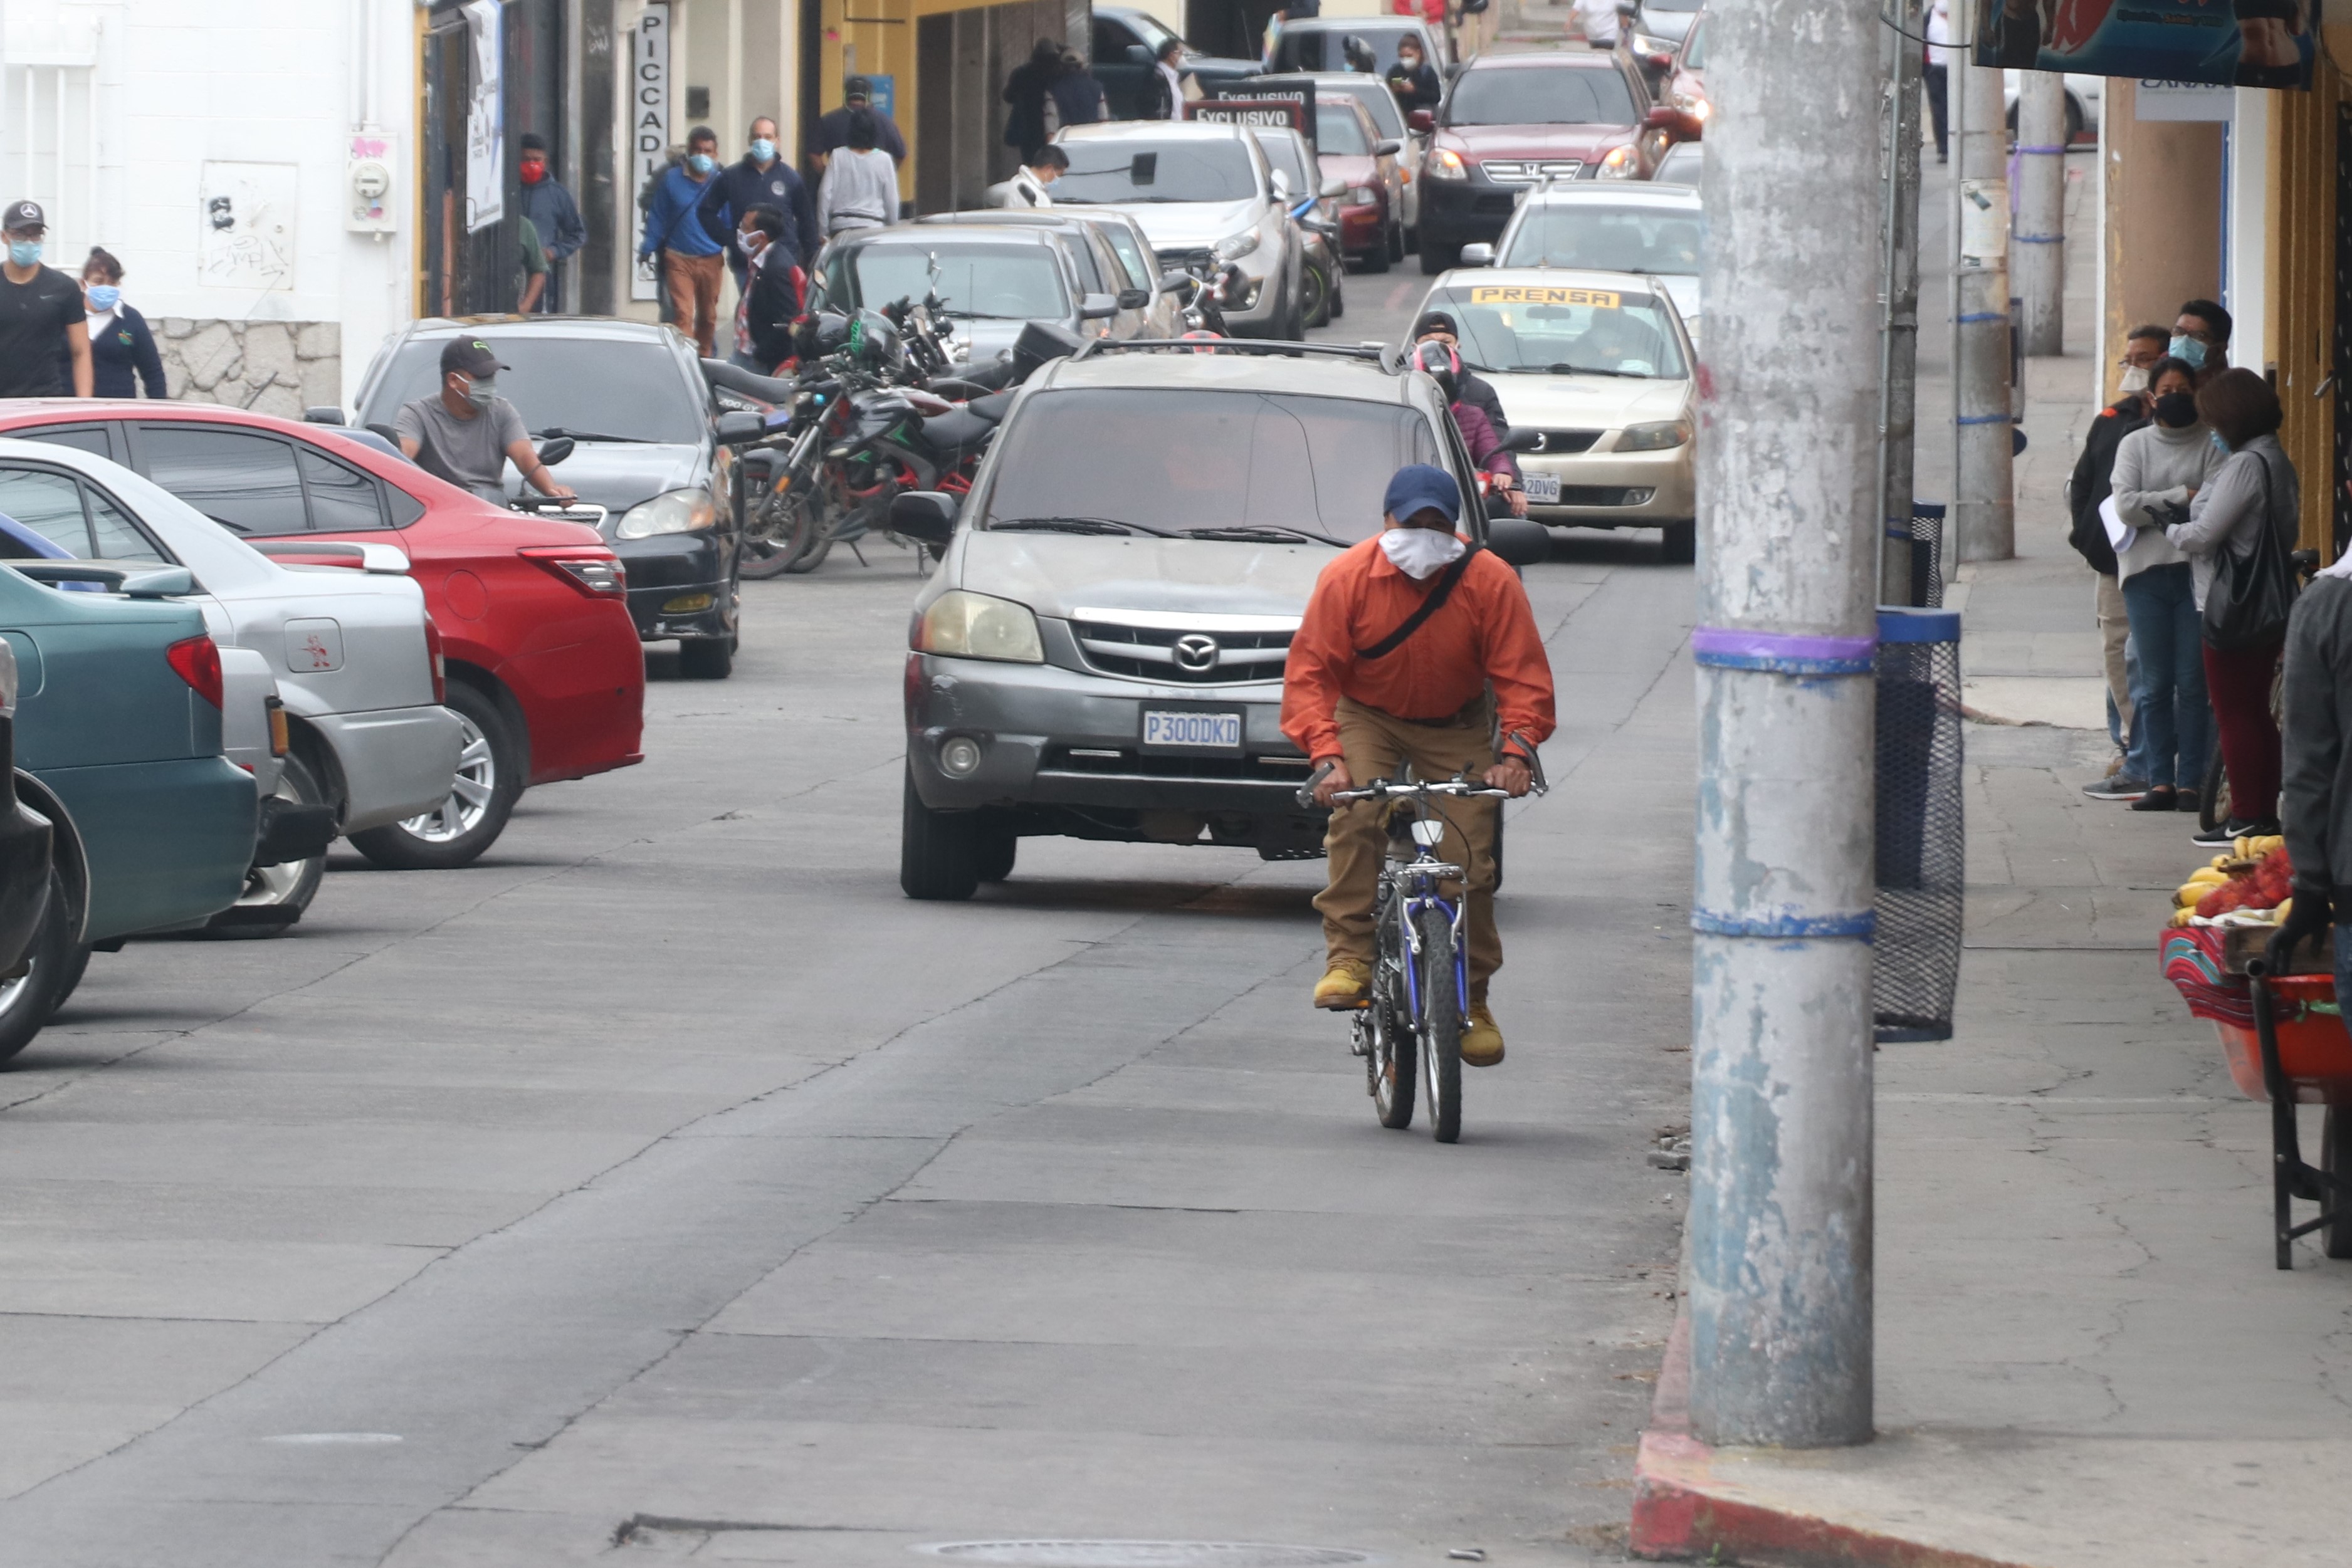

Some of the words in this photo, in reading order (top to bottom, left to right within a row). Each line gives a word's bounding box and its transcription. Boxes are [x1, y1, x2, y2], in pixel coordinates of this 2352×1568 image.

[1196, 108, 1288, 126] EXCLUSIVO
[1481, 288, 1610, 306] PRENSA
[1523, 479, 1557, 495] 2DVG
[1147, 716, 1239, 744] P300DKD
